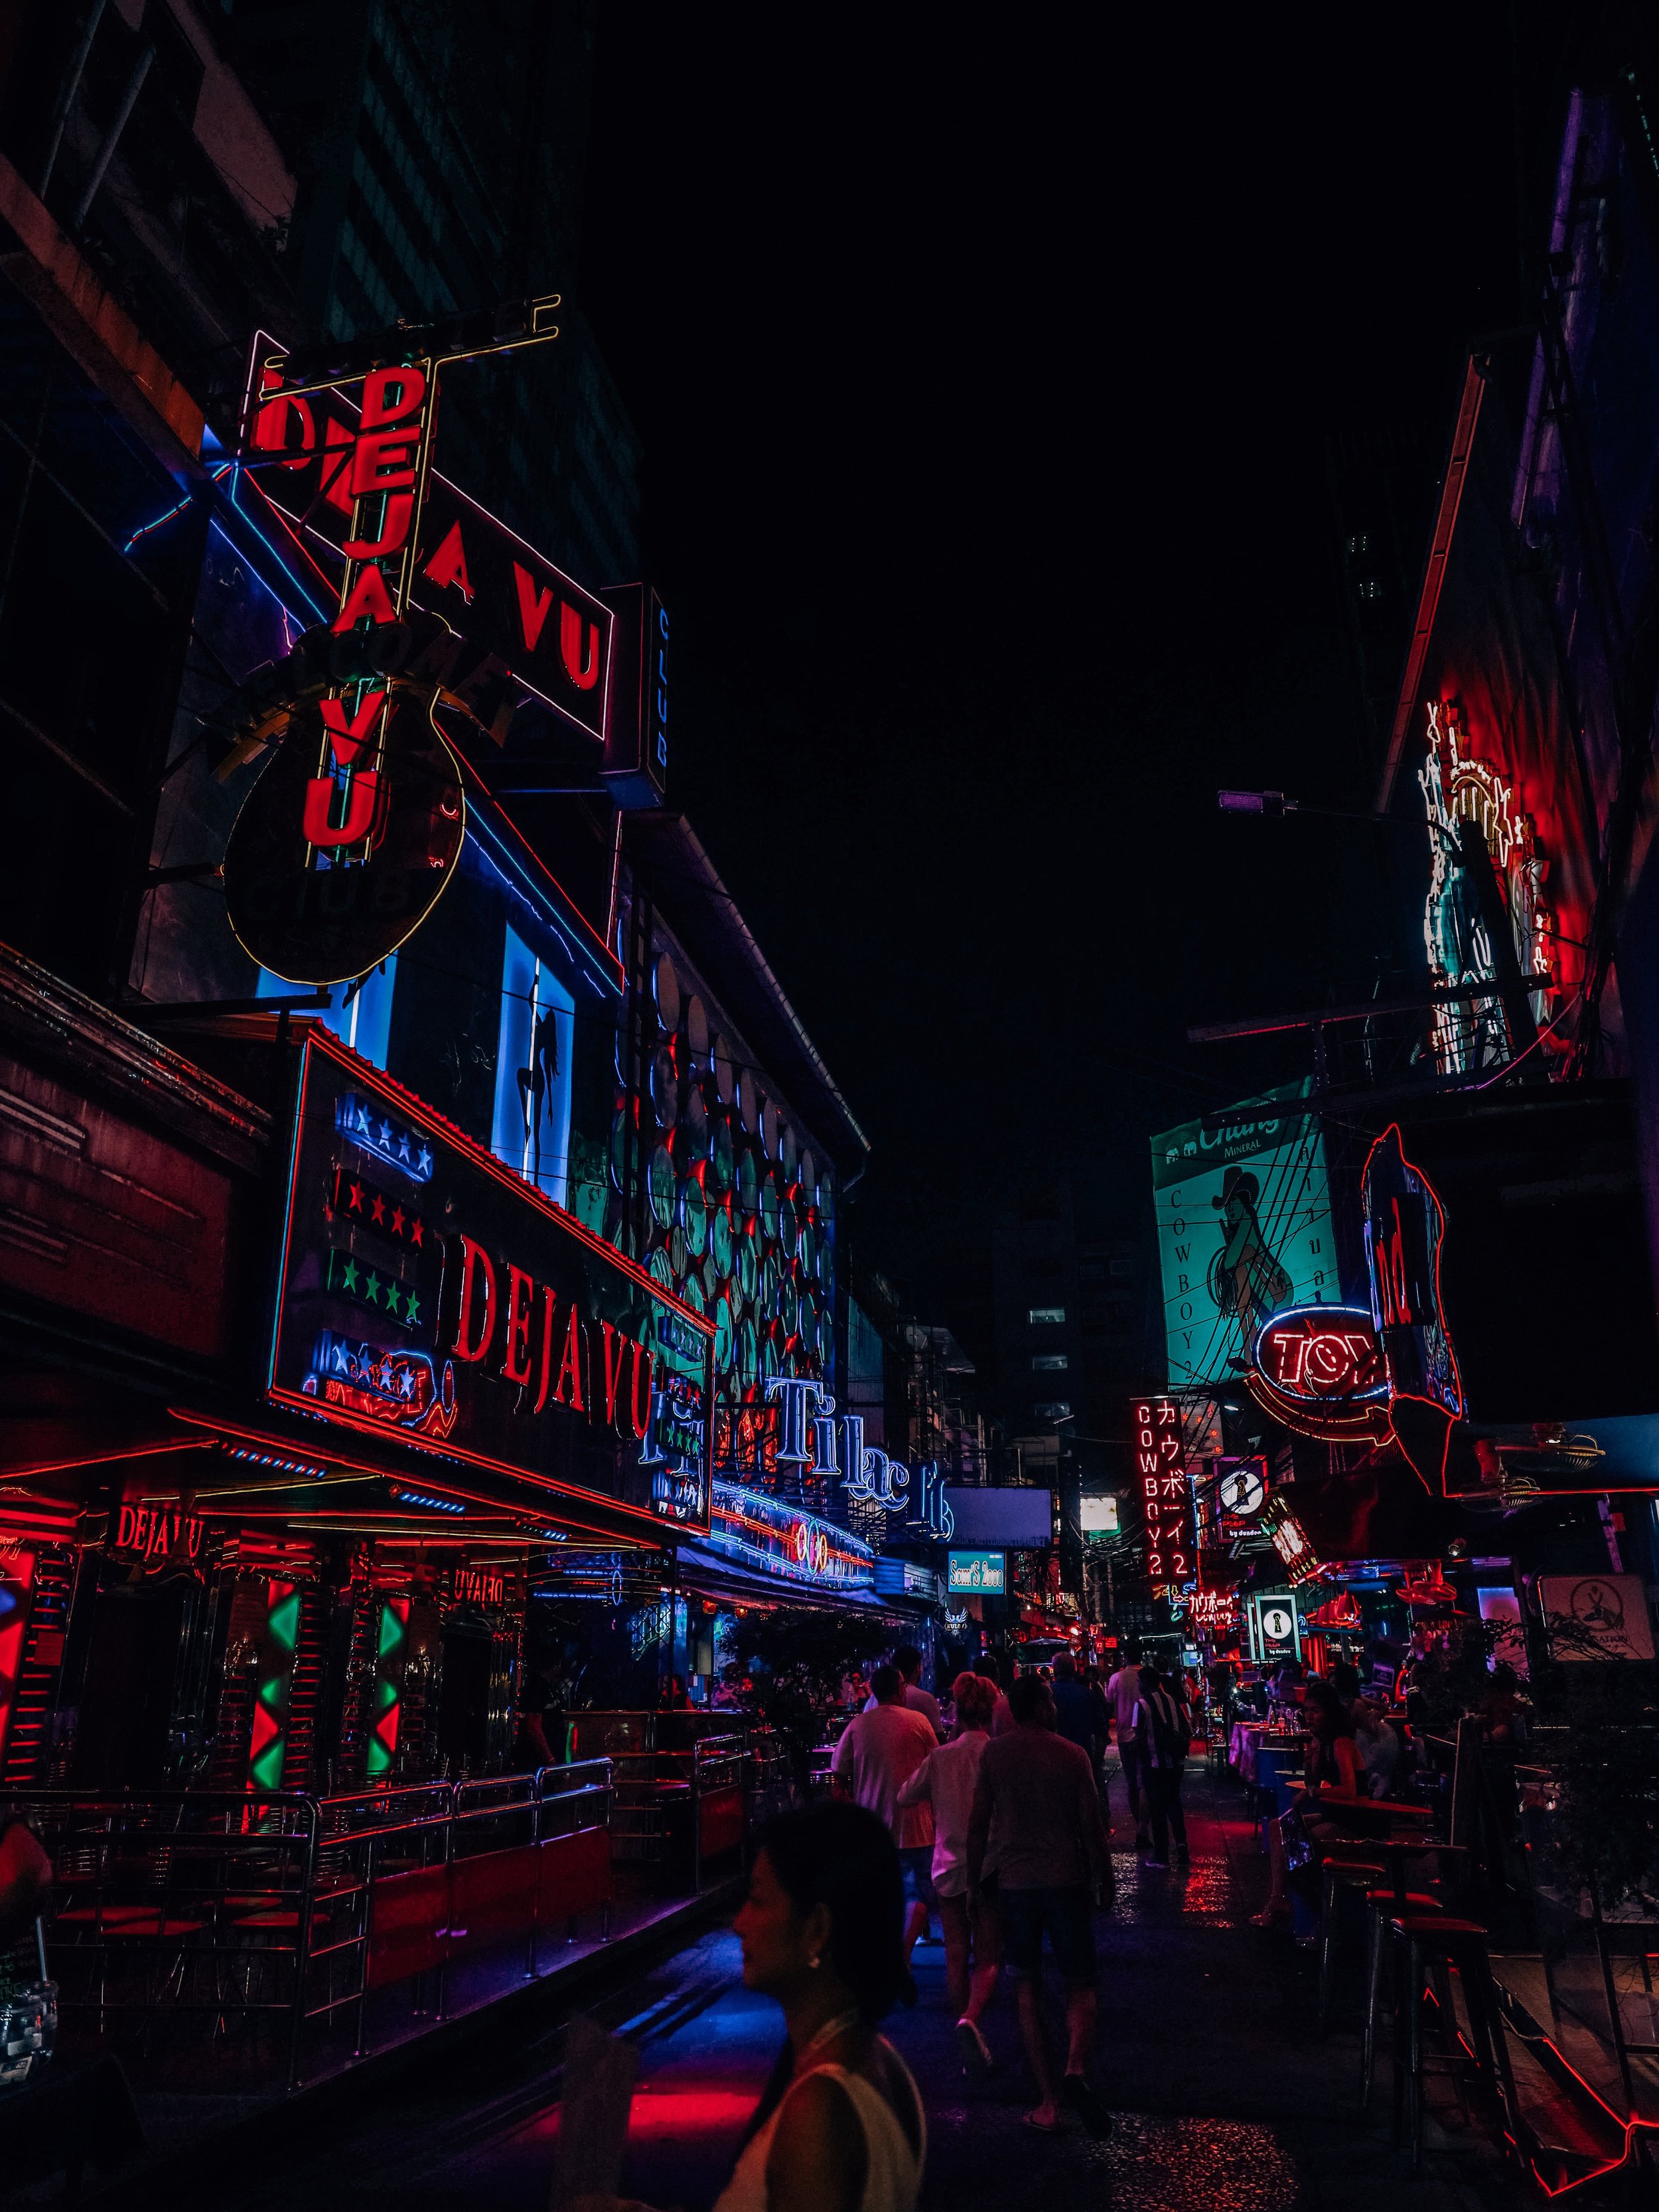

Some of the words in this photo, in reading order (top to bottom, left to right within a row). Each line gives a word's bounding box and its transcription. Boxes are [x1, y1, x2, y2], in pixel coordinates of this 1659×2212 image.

[250, 365, 475, 607] DA
[658, 607, 668, 766] CLUB
[1224, 1139, 1262, 1159] MINERAL
[1300, 1145, 1325, 1286] คาวบอ
[764, 1376, 910, 1512] Tilac
[981, 1560, 1004, 1587] 2000
